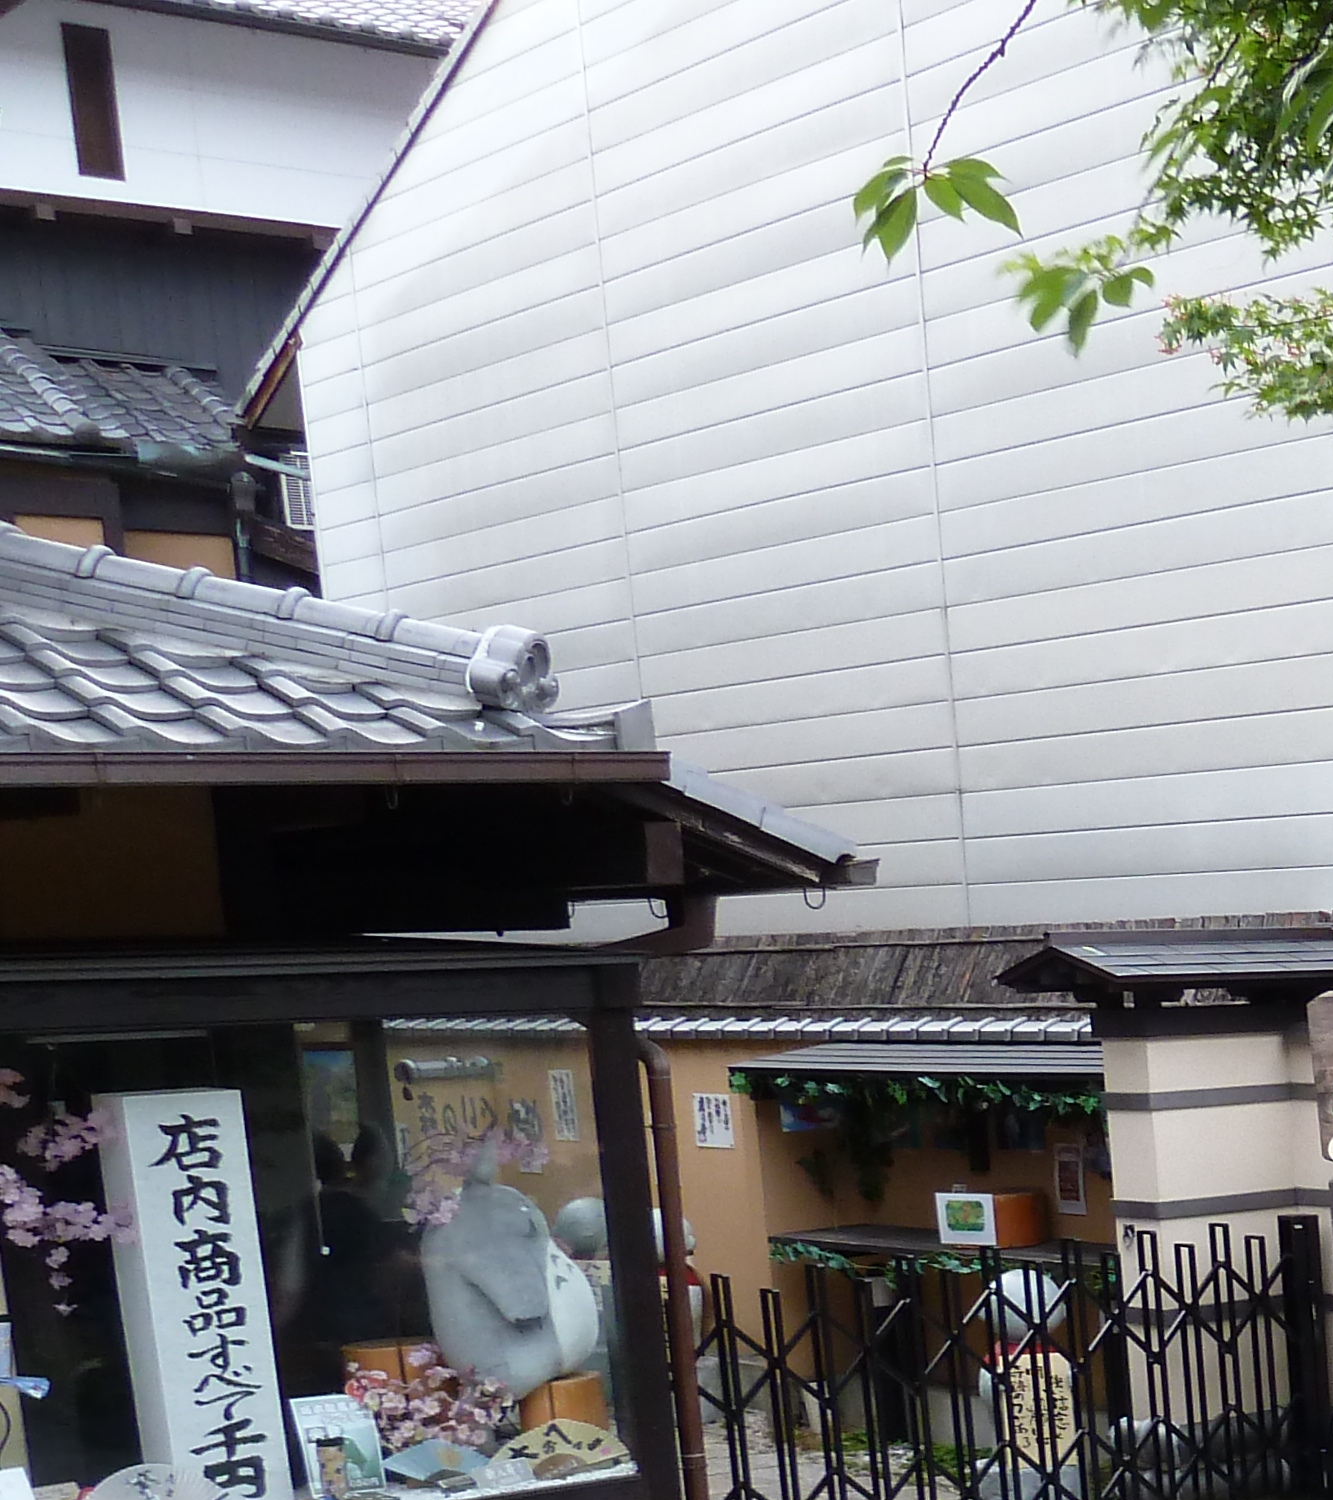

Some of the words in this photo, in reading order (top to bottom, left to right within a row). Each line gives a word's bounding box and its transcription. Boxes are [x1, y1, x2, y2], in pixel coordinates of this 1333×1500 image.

[148, 1114, 268, 1499] 店内商品すべて千円
